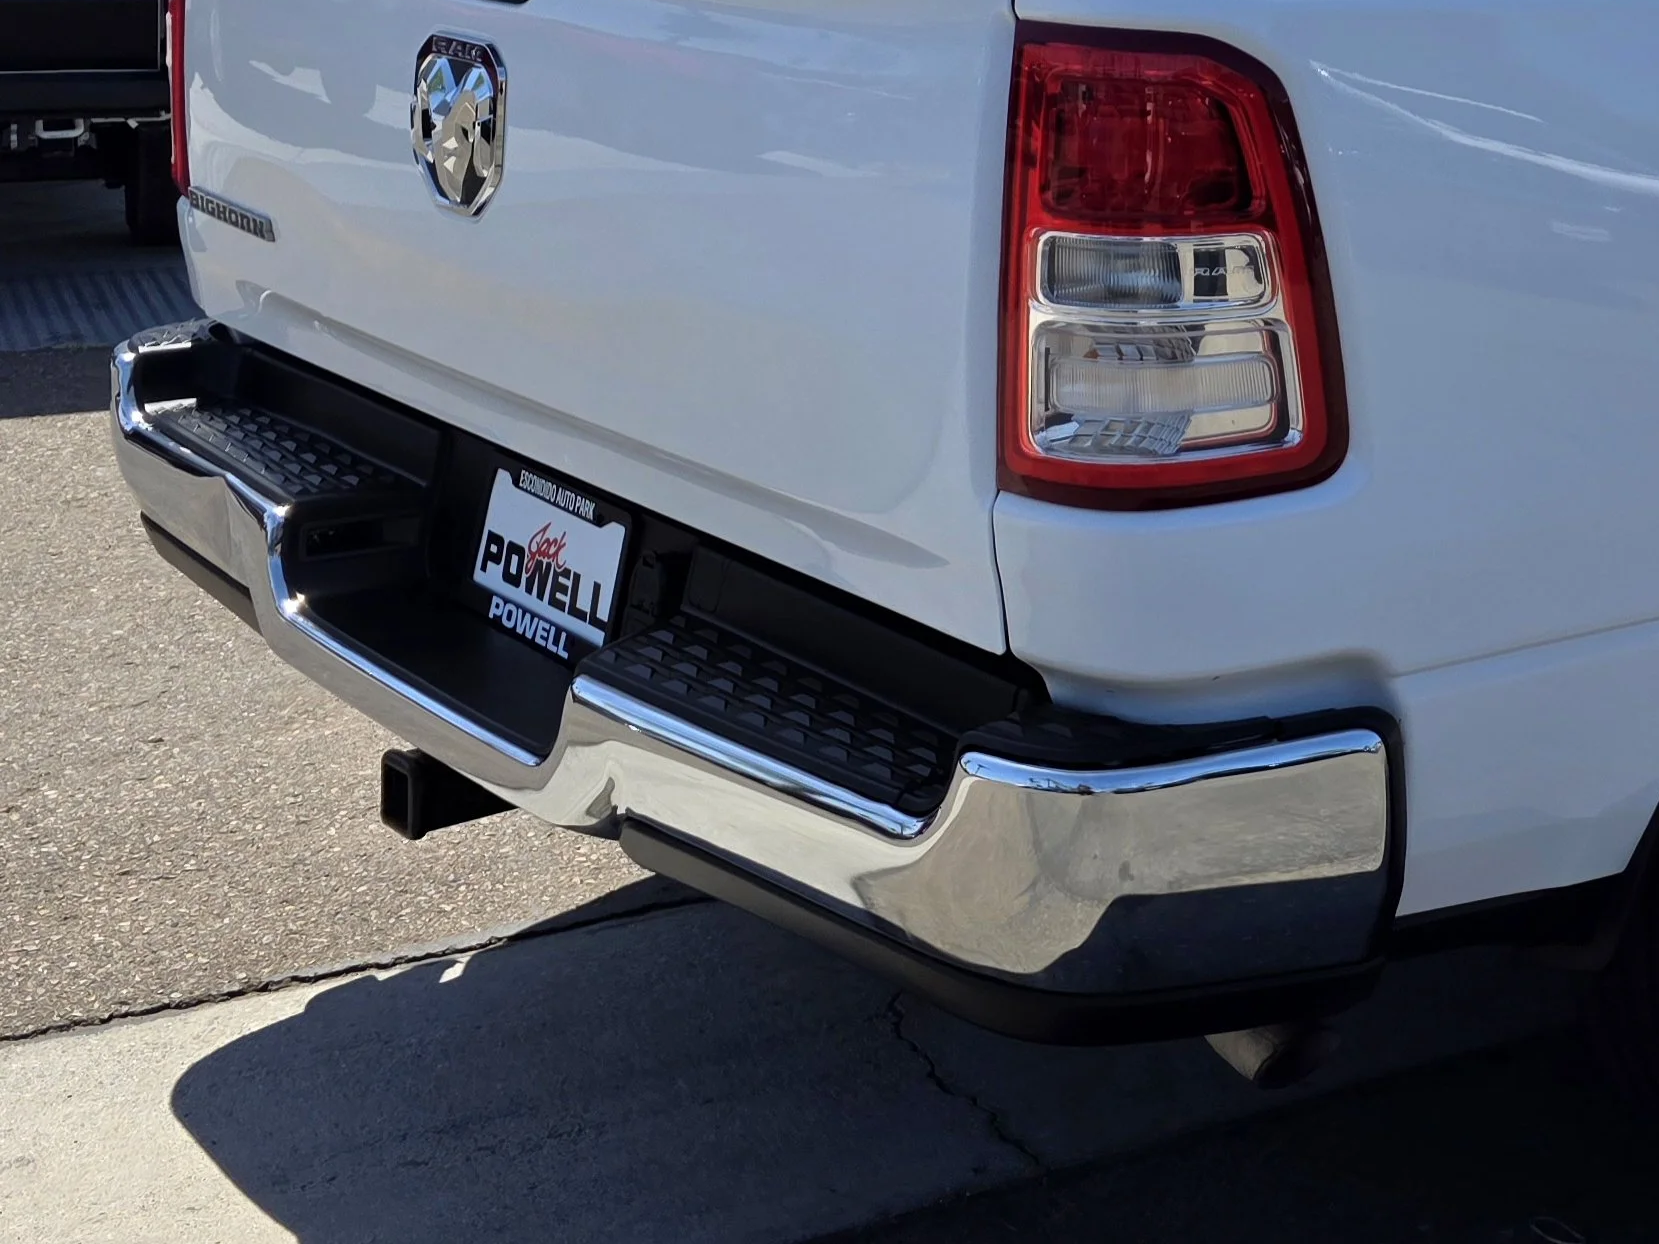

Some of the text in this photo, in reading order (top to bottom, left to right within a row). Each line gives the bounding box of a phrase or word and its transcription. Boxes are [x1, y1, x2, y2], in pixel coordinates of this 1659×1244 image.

[432, 36, 485, 62] RAM
[519, 469, 596, 520] ESCONDIDO AUTO PARK
[526, 521, 567, 573] Jack
[480, 529, 608, 629] POWELL
[488, 595, 570, 660] POWELL
